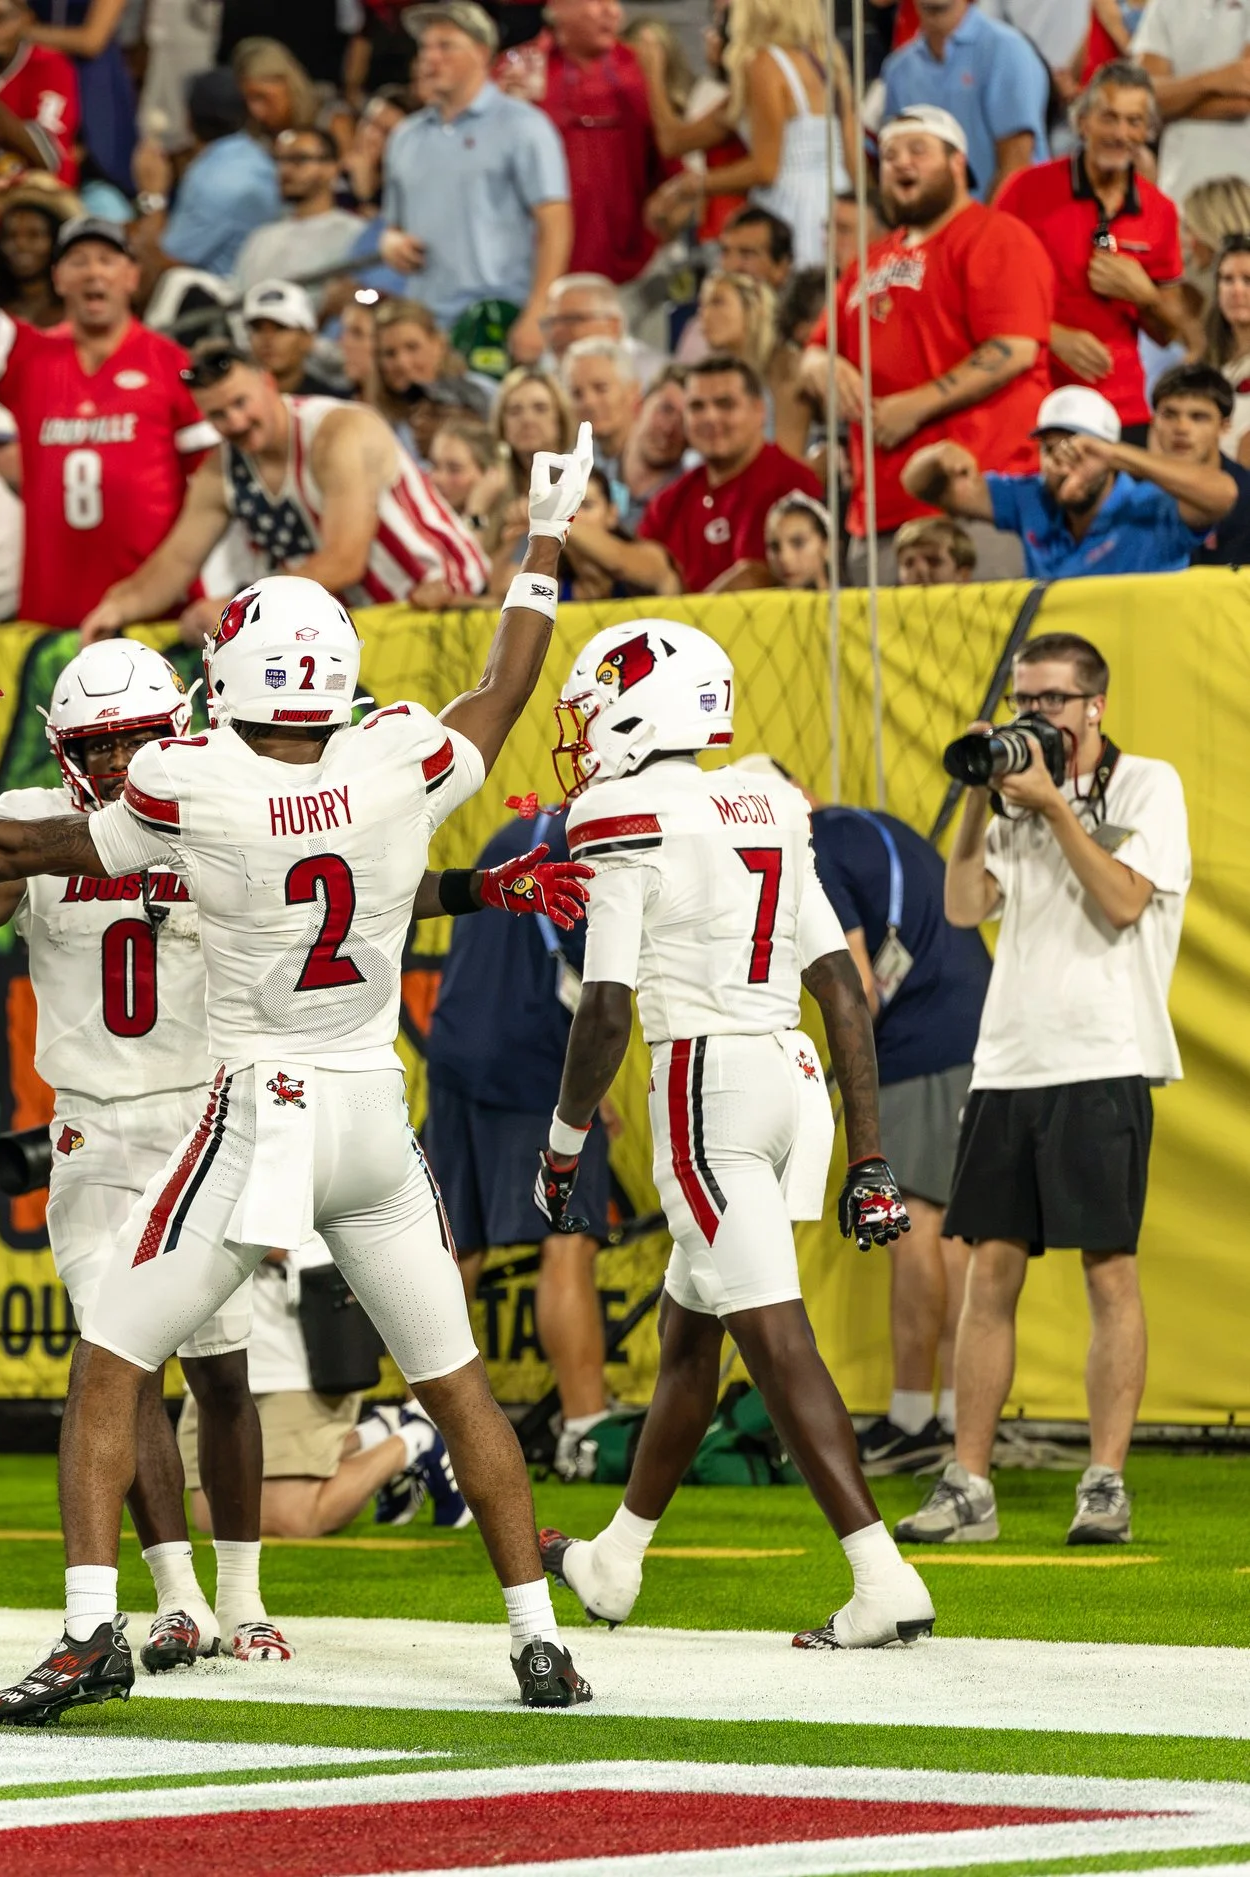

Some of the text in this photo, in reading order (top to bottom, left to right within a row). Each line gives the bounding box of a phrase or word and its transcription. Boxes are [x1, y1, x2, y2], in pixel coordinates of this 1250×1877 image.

[63, 448, 103, 530] 8
[299, 656, 315, 689] 2
[95, 706, 121, 720] ACC
[271, 709, 333, 723] LOUISVILLE
[268, 785, 352, 836] HURRY
[710, 794, 776, 825] McCOY
[285, 853, 367, 992] 2
[732, 847, 783, 985] 7
[101, 917, 158, 1038] 0
[475, 1288, 628, 1362] TAE
